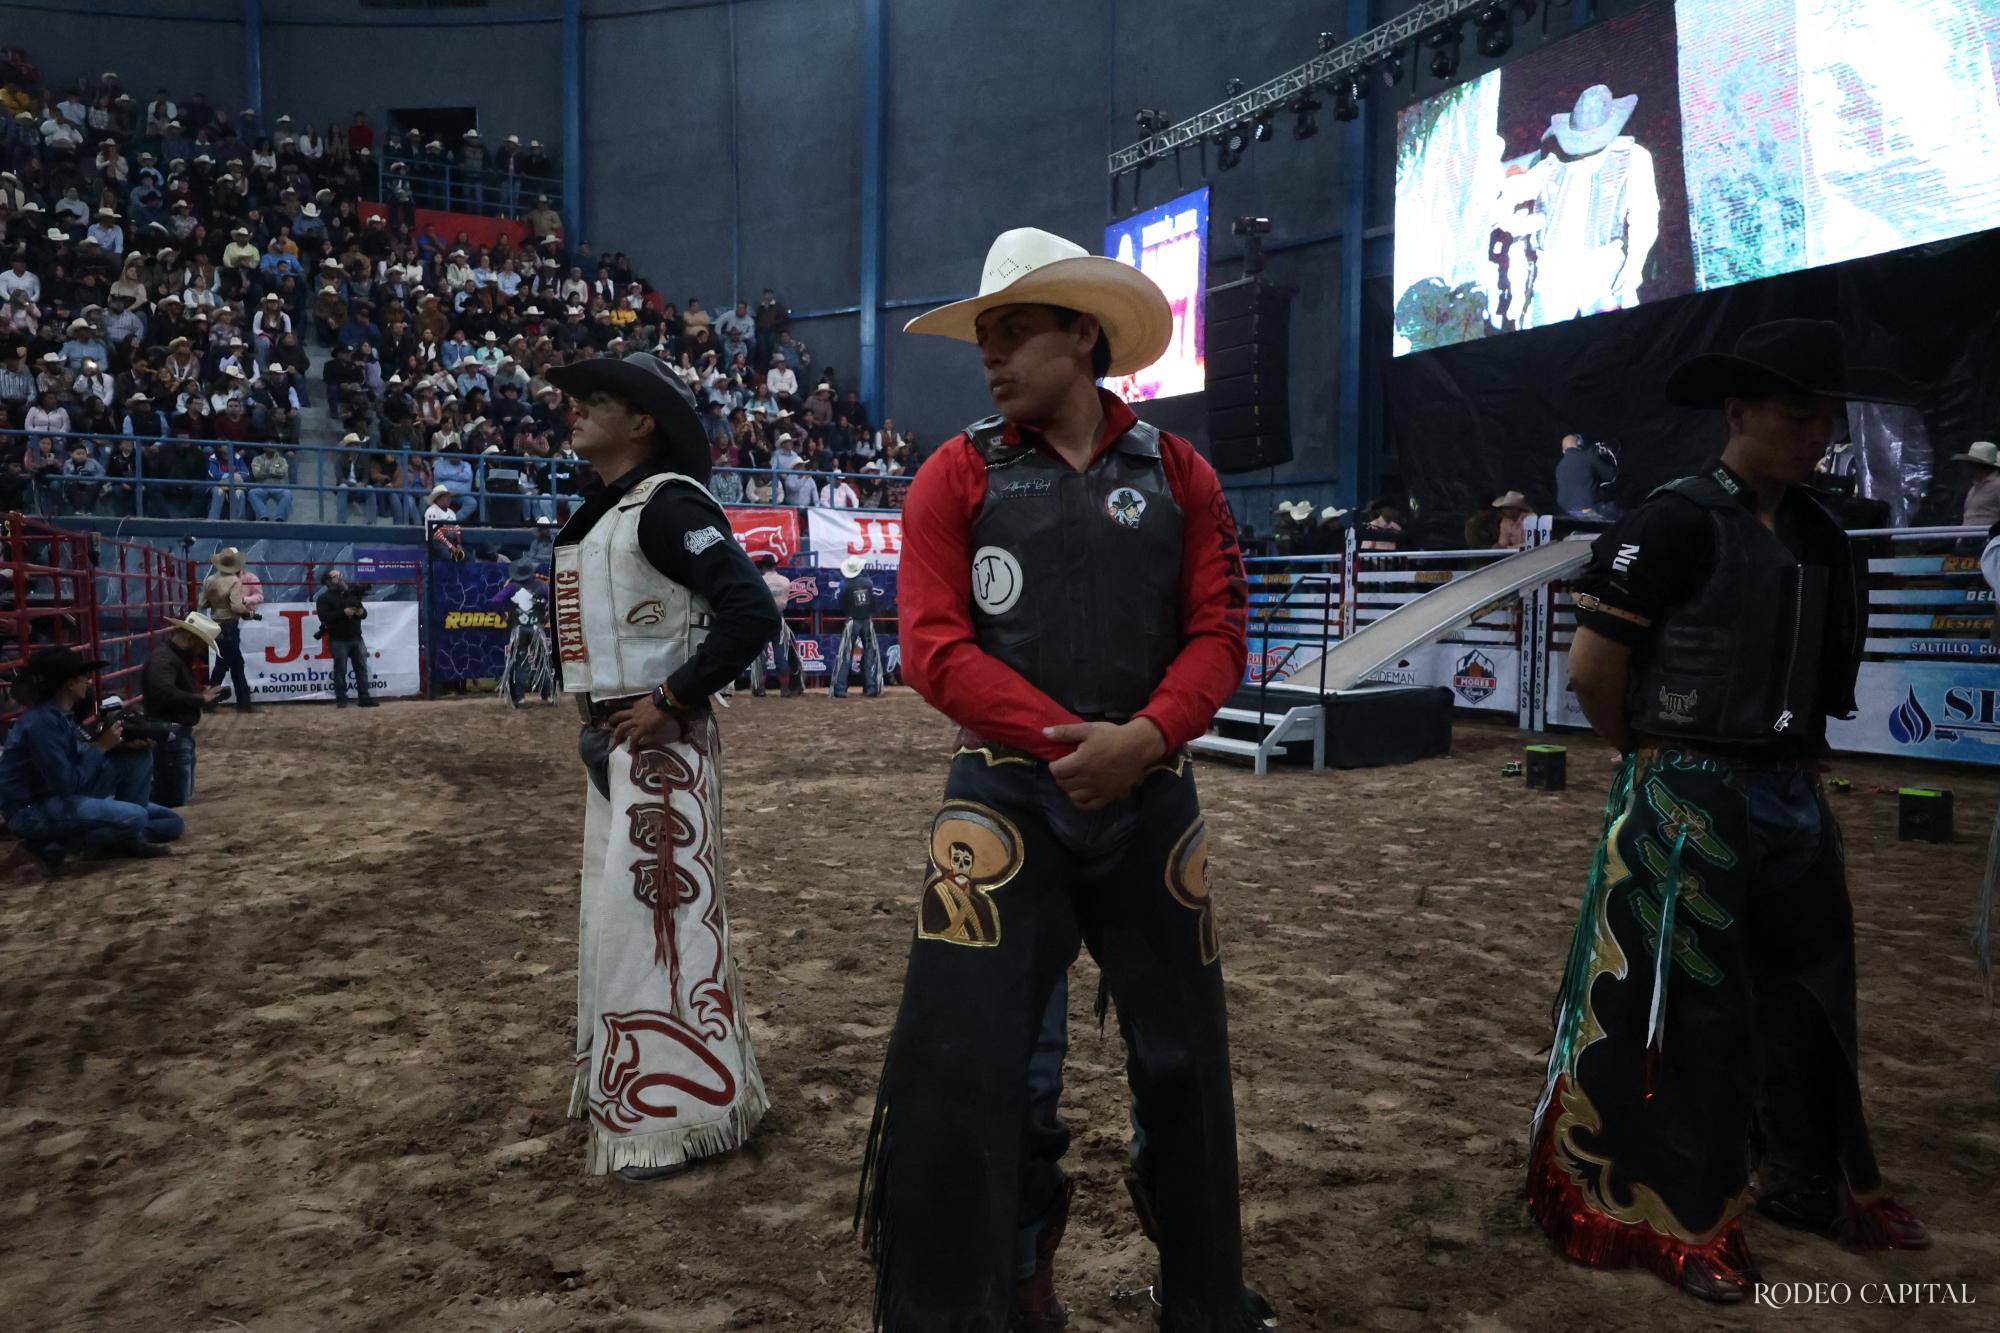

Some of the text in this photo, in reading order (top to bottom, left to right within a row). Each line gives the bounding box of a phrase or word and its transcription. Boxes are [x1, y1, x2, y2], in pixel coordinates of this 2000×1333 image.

[1967, 590, 1996, 601] DEL
[556, 570, 586, 663] REINING
[1911, 642, 1974, 655] SALTILLO,
[1248, 653, 1282, 666] REIING
[1522, 604, 1530, 709] EXPRESS
[1535, 604, 1544, 710] EXPRESS
[262, 684, 308, 694] BOUTIQUE
[310, 682, 323, 692] DE
[324, 682, 336, 691] LO
